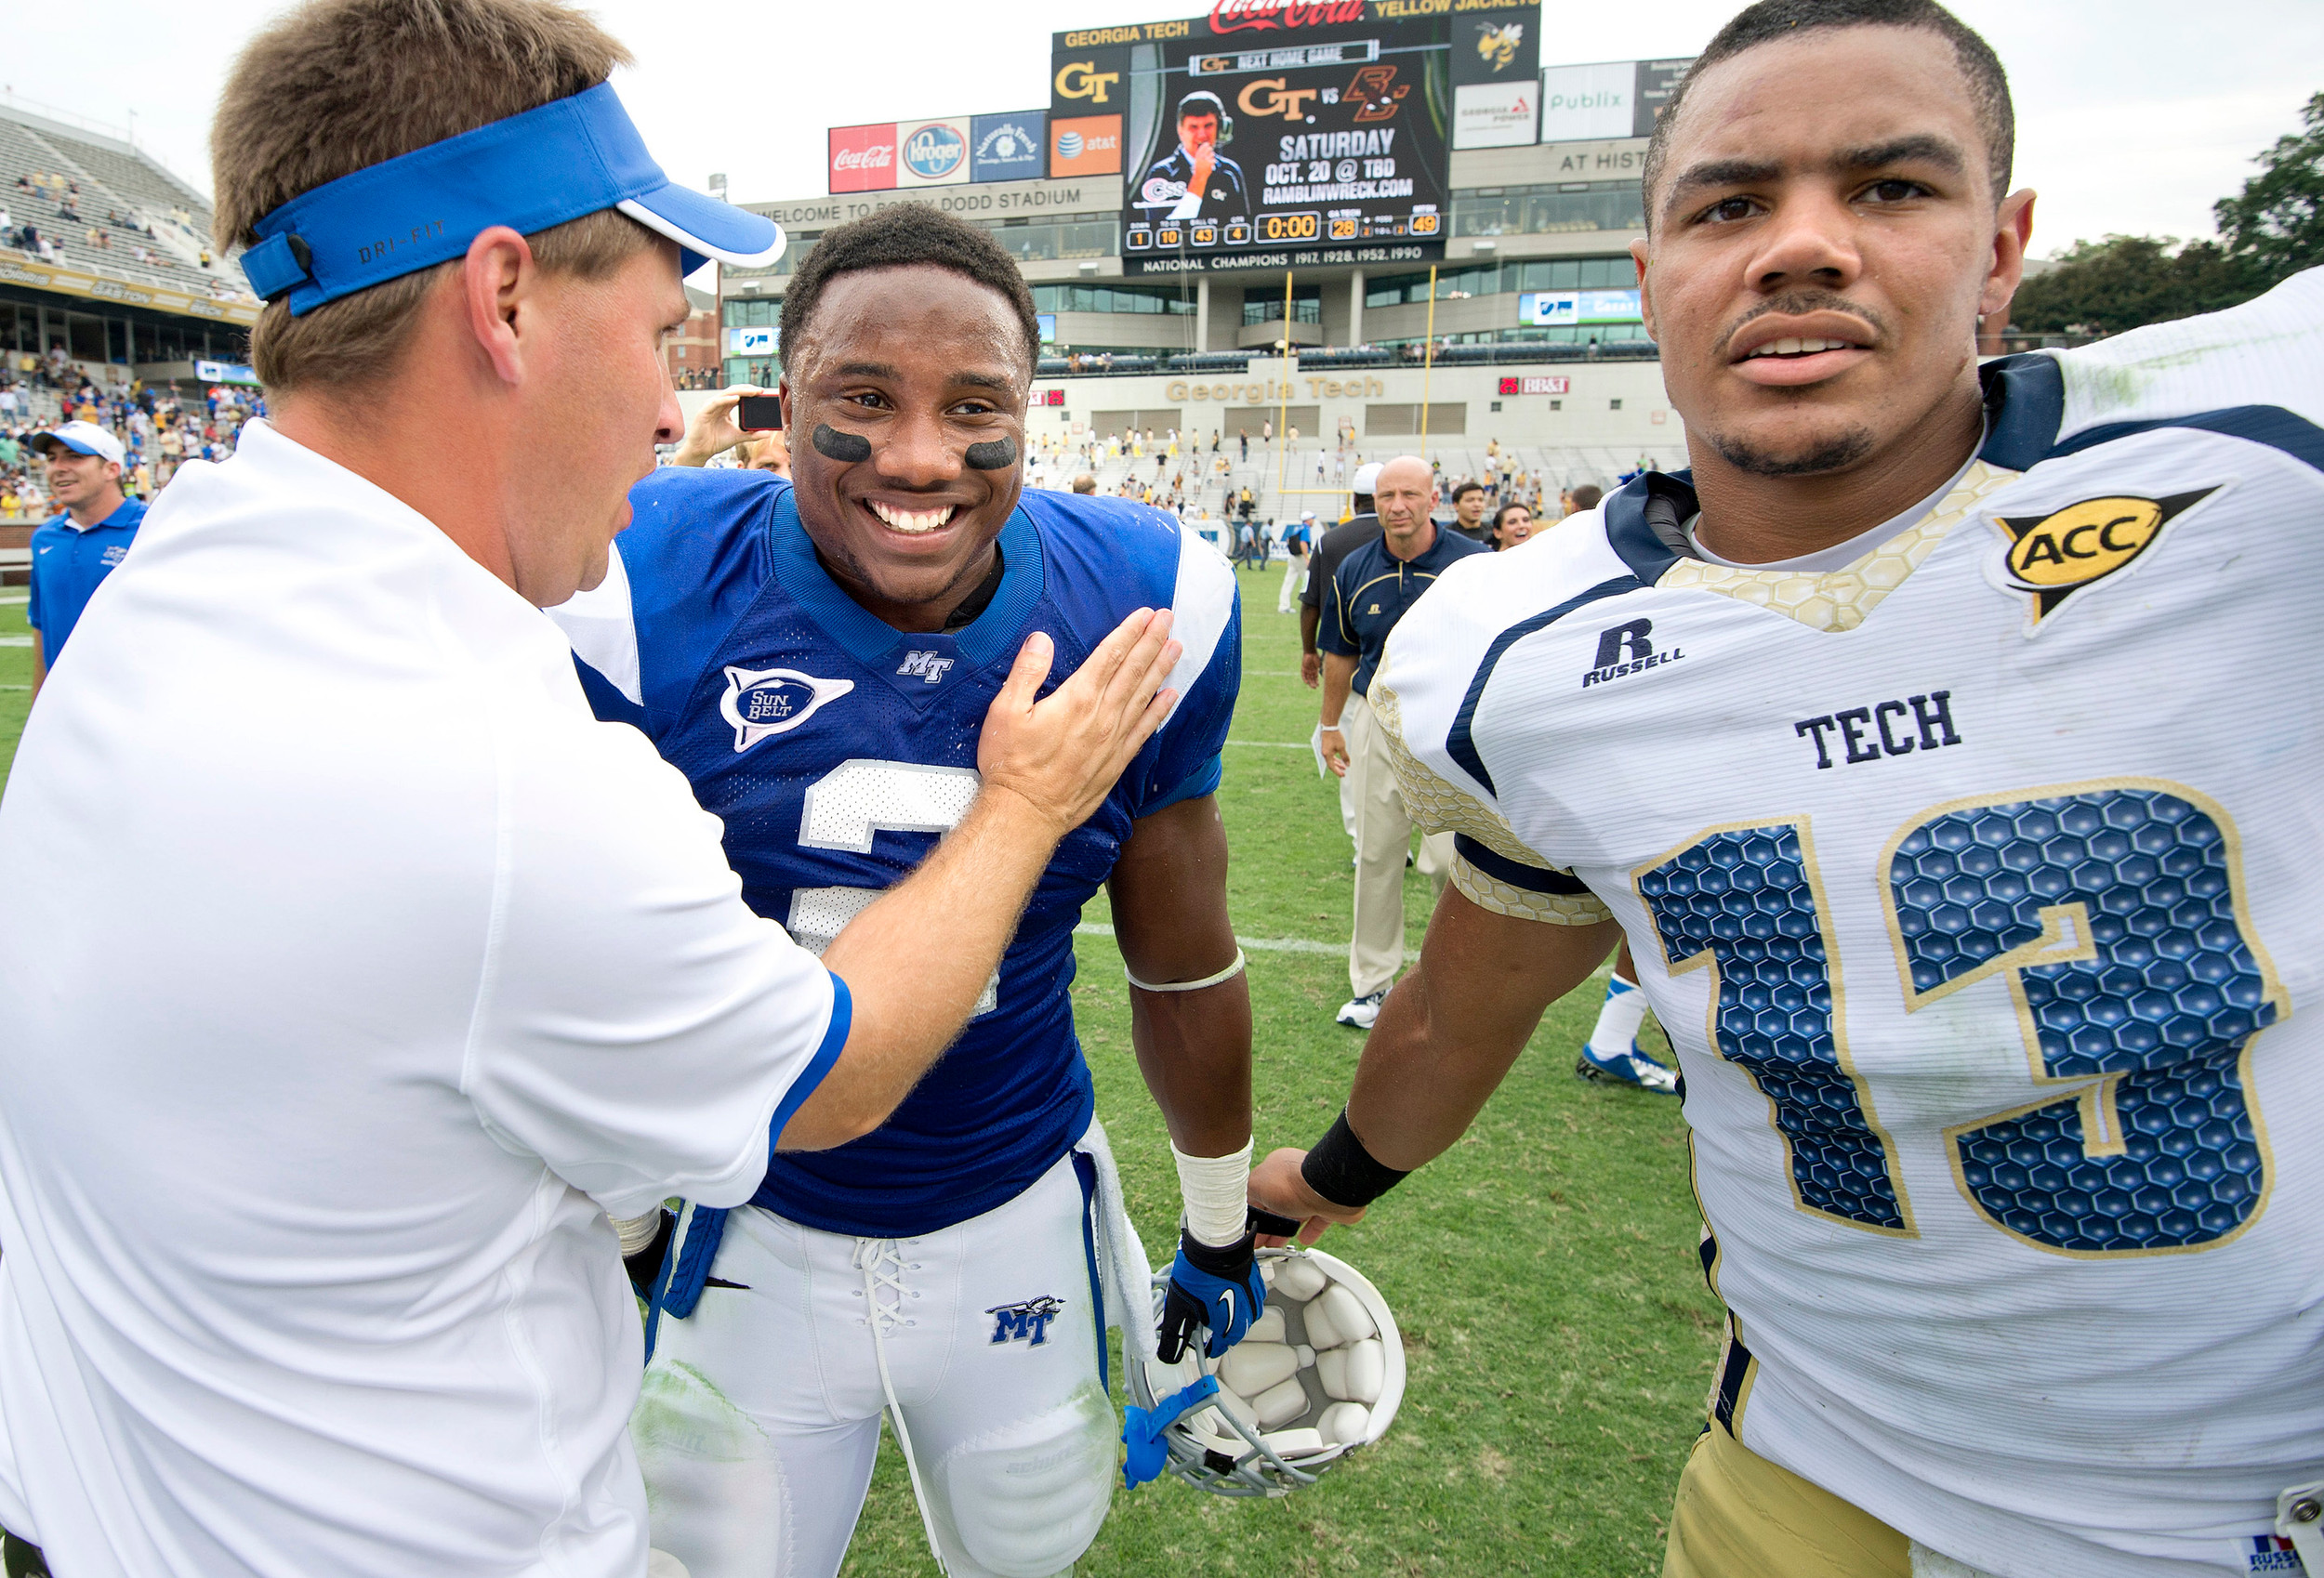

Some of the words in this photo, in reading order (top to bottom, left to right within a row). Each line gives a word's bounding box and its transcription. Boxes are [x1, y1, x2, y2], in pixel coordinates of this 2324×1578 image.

[1375, 0, 1450, 18] YELLOW
[1064, 26, 1141, 47] GEORGIA
[1144, 21, 1189, 39] TECH
[1237, 53, 1268, 70] NEXT
[1055, 60, 1118, 103] GT
[1237, 77, 1316, 121] GT
[1551, 92, 1621, 110] Publix
[909, 131, 961, 173] Kroger
[1087, 135, 1116, 151] at&t
[1279, 127, 1395, 162] SATURDAY
[1265, 163, 1304, 185] OCT.
[1308, 160, 1331, 182] 20
[1335, 159, 1358, 183] @
[1363, 158, 1395, 178] TBD
[1560, 155, 1587, 171] AT
[1262, 178, 1413, 205] RAMBLINWRECK.COM
[757, 205, 840, 224] WELCOME
[848, 203, 870, 217] TO
[941, 195, 992, 211] DODD
[999, 189, 1080, 208] STADIUM
[1161, 230, 1178, 243] 10
[1195, 229, 1213, 242] 43
[1232, 227, 1242, 240] 4
[1267, 215, 1316, 239] 0:00
[1332, 220, 1354, 236] 28
[1413, 216, 1436, 231] 49
[358, 219, 445, 264] DRI-FIT
[1136, 232, 1142, 245] 1
[1142, 257, 1205, 272] NATIONAL
[1210, 253, 1288, 270] CHAMPIONS
[1391, 246, 1422, 259] 1990
[1166, 378, 1294, 404] Georgia
[1305, 375, 1384, 399] Tech
[1524, 377, 1568, 394] BB&T
[2019, 514, 2140, 574] ACC
[1593, 618, 1653, 670] R
[895, 651, 955, 684] MT
[1582, 648, 1685, 688] RUSSELL
[1795, 690, 1961, 770] TECH
[1630, 776, 2292, 1259] 13
[988, 1308, 1056, 1350] MT
